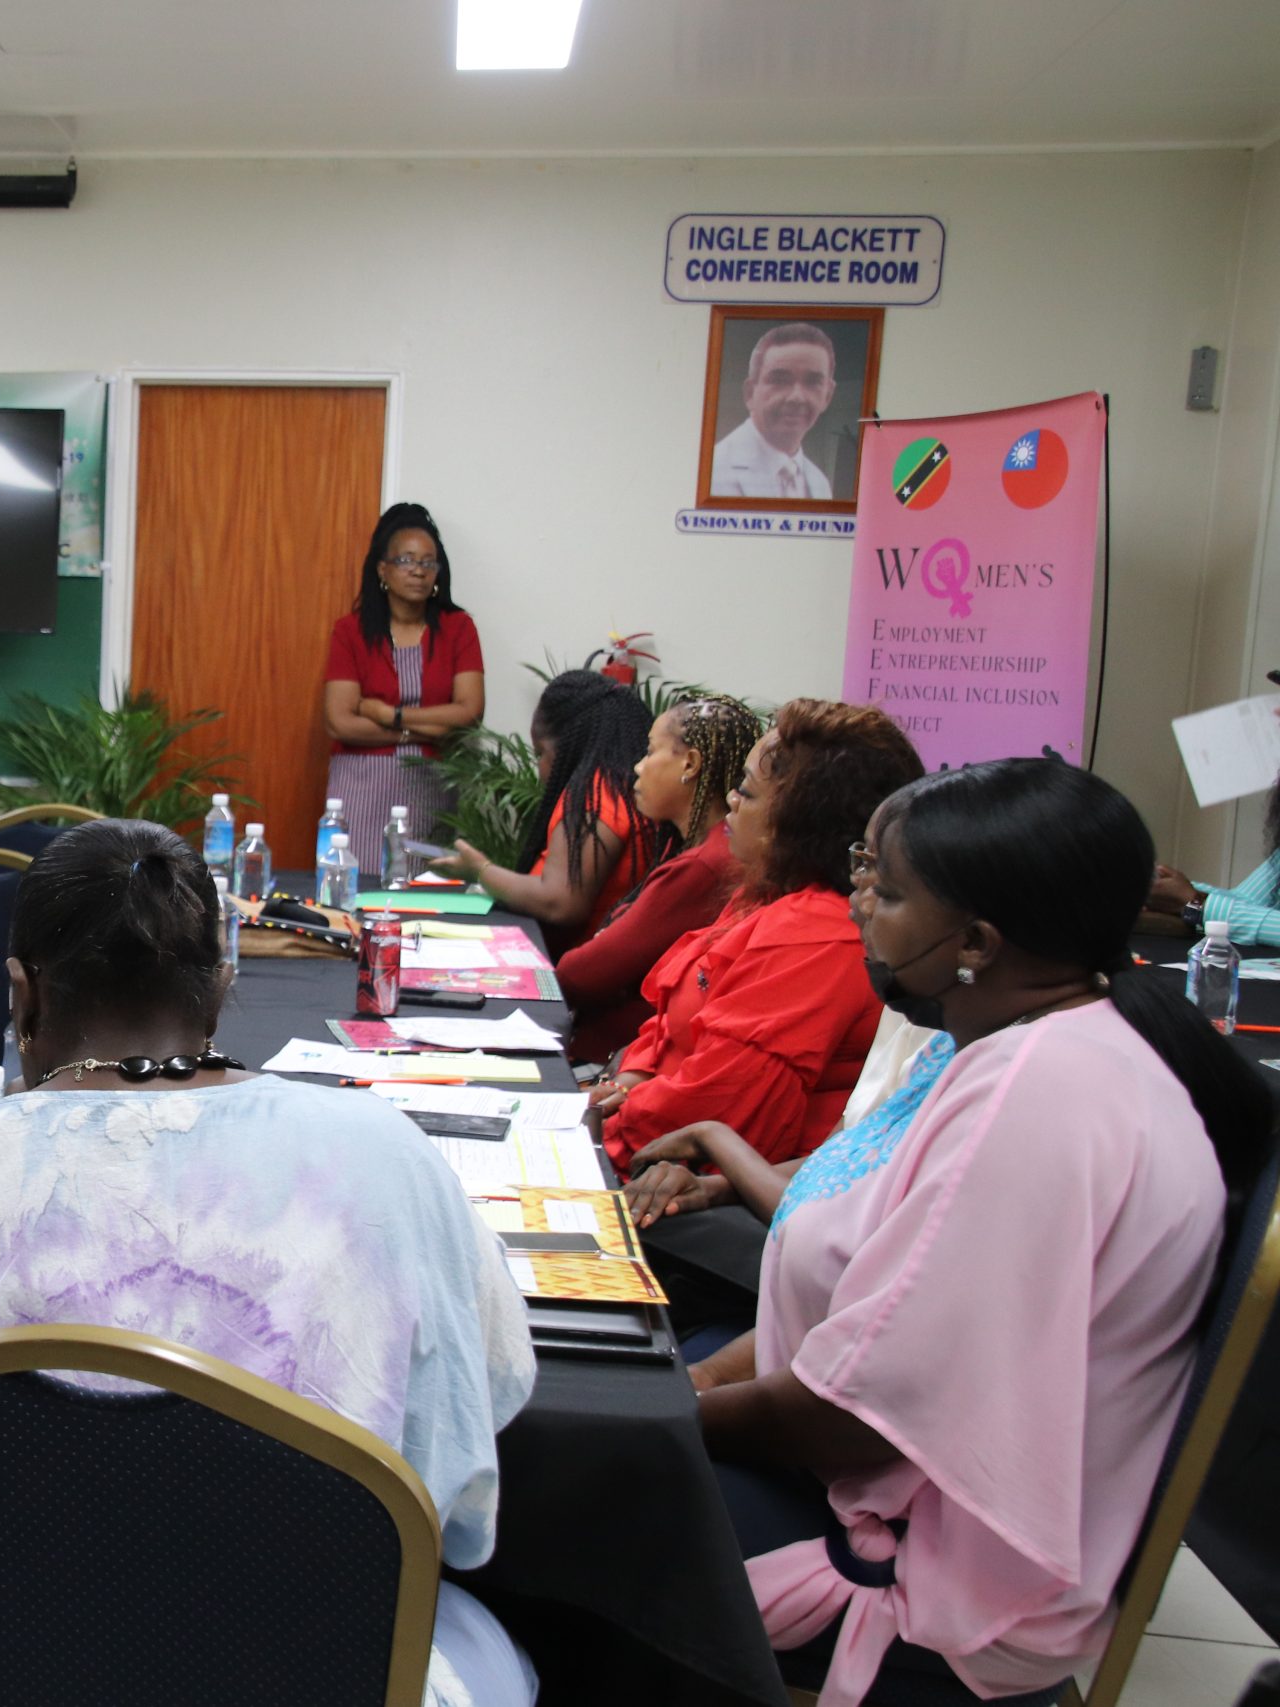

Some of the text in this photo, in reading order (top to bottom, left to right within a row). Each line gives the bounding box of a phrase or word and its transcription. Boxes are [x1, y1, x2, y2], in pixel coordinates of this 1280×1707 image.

[688, 226, 921, 252] INGLE BLACKETT
[685, 259, 919, 284] CONFERENCE ROOM
[681, 515, 774, 530] VISIONARY
[779, 518, 792, 531] &
[965, 686, 1060, 707] INCLUSION
